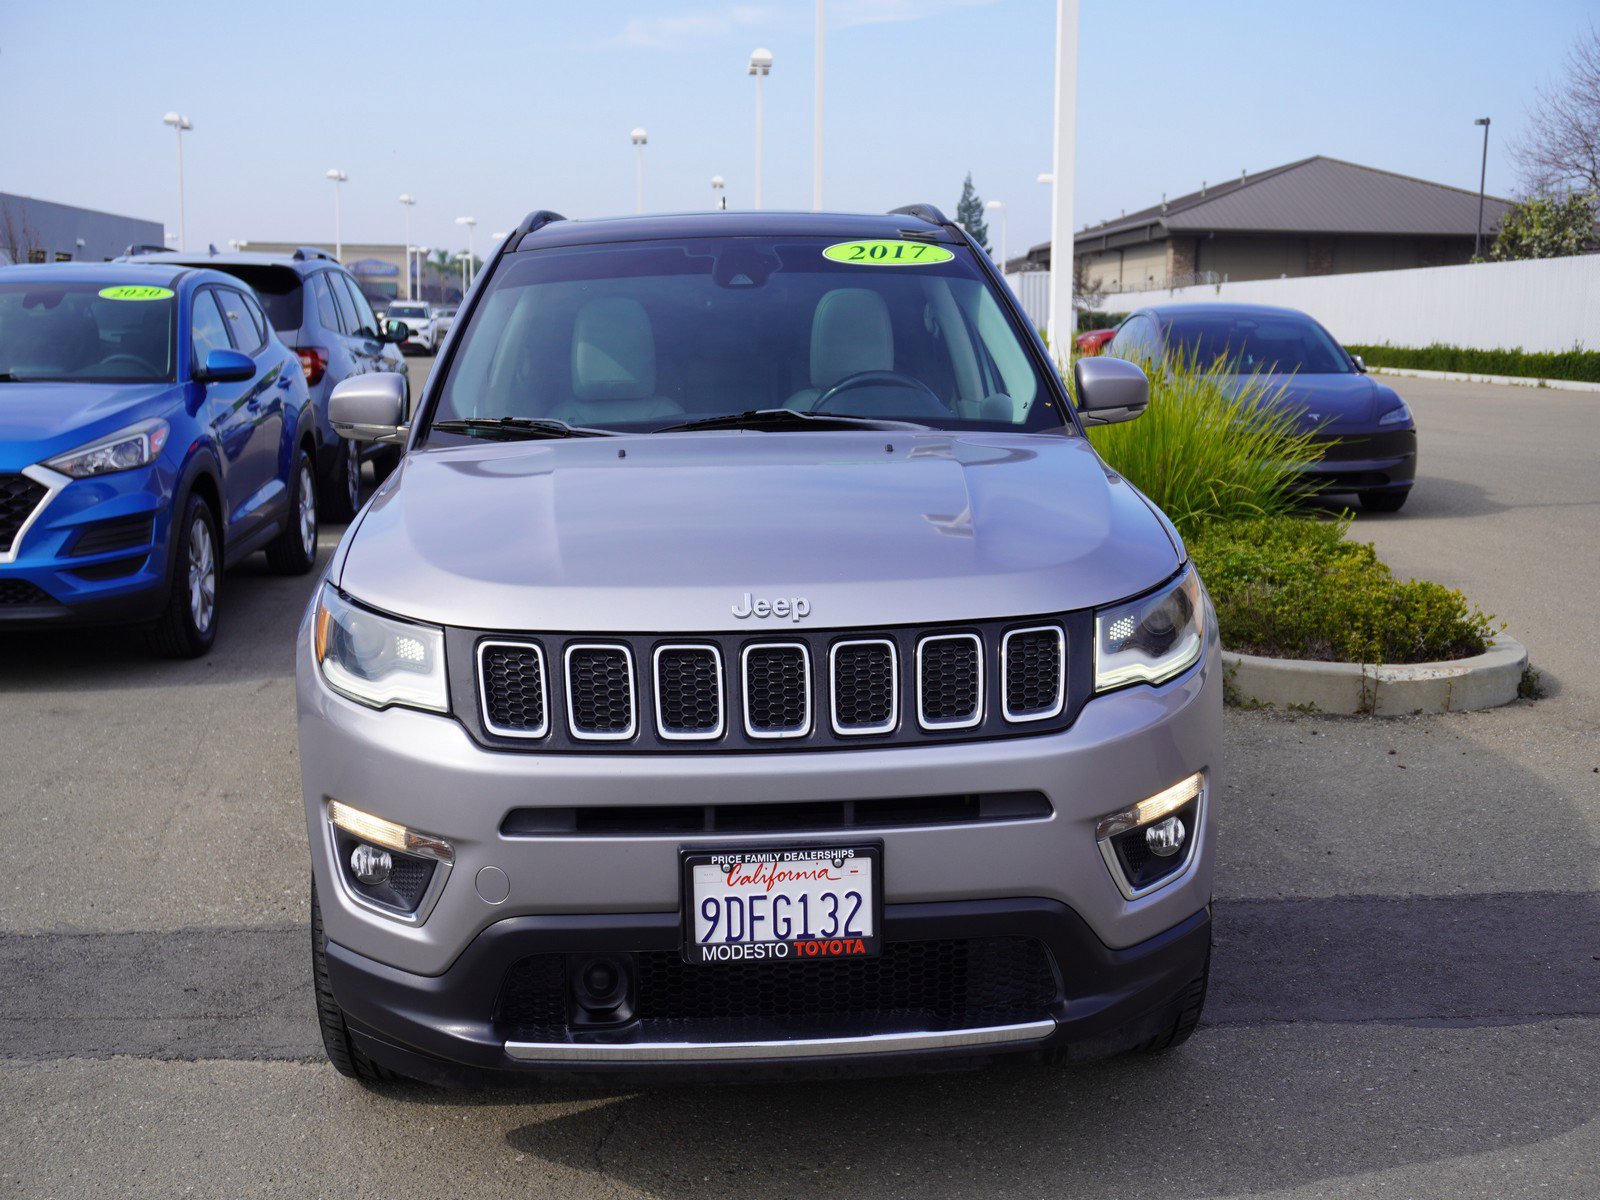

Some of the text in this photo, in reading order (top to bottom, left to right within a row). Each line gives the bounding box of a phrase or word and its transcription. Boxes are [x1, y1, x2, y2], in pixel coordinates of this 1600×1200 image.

[848, 245, 928, 260] 2017
[111, 288, 162, 298] 2020
[731, 592, 811, 623] Jeep
[711, 849, 855, 865] PRICE FAMILY DEALERSHIPS
[726, 863, 842, 892] California
[701, 891, 863, 943] 9DFG132
[702, 939, 866, 961] MODESTO TOYOTA
